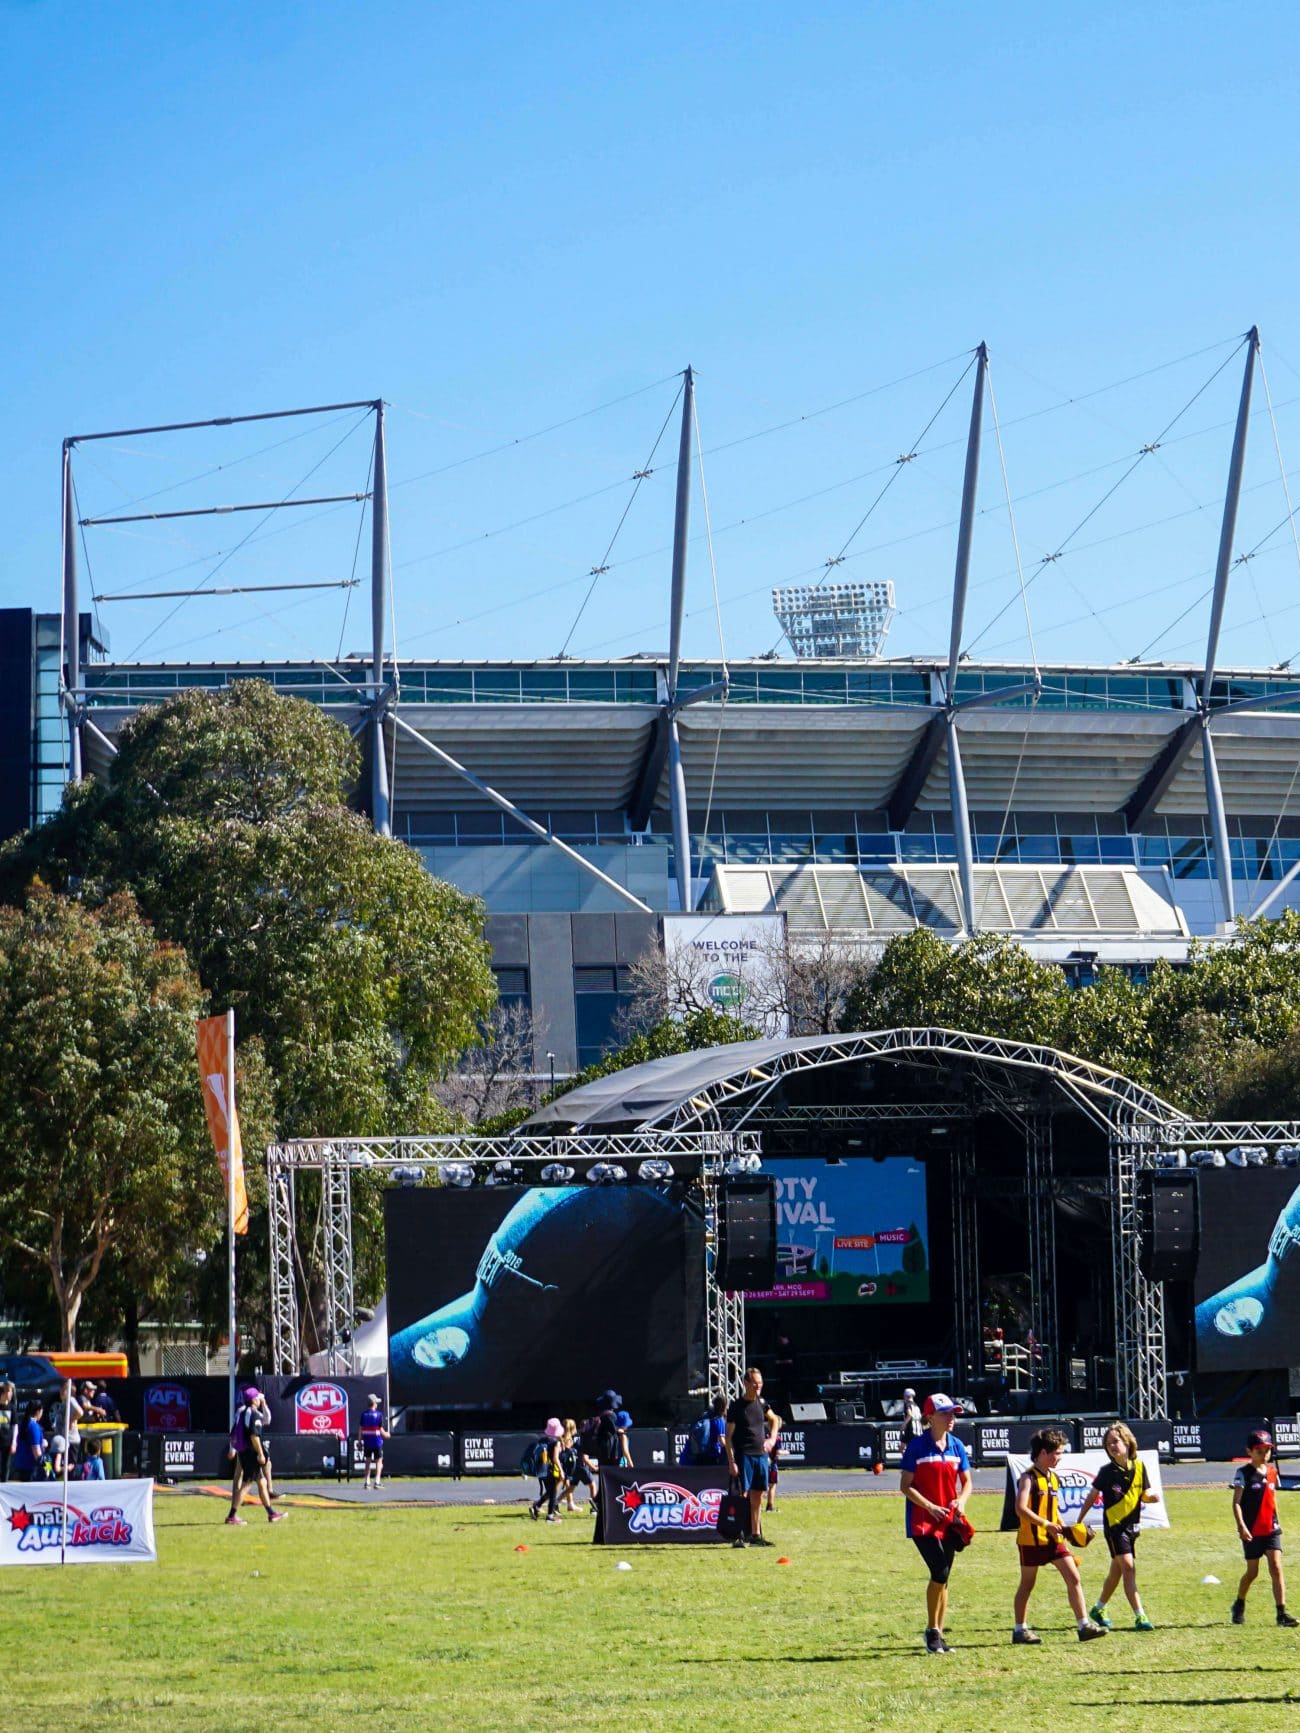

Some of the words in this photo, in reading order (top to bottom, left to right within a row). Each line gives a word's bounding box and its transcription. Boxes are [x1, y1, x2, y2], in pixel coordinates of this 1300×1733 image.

[692, 940, 758, 951] WELCOME
[703, 953, 720, 962] TO
[724, 952, 749, 962] THE
[879, 1234, 905, 1242] MUSIC
[837, 1241, 853, 1249] LIVE
[854, 1239, 869, 1248] SITE
[300, 1390, 344, 1407] AFL
[1083, 1427, 1099, 1437] CITY
[1173, 1425, 1190, 1435] CITY
[1191, 1425, 1201, 1435] OF
[1275, 1423, 1291, 1433] CITY
[675, 1434, 689, 1445] CIT
[794, 1432, 805, 1441] OF
[885, 1430, 901, 1441] CITY
[981, 1428, 998, 1440] CITY
[999, 1428, 1009, 1439] OF
[1173, 1434, 1201, 1445] EVENTS
[165, 1441, 183, 1451] CITY
[184, 1440, 195, 1450] OF
[464, 1438, 482, 1450] CITY
[483, 1438, 495, 1449] OF
[780, 1442, 805, 1451] VENTS
[981, 1438, 1010, 1449] EVENTS
[1083, 1437, 1104, 1447] EVEN
[164, 1451, 195, 1463] EVENTS
[464, 1448, 495, 1460] EVENTS
[644, 1489, 677, 1504] nab
[701, 1493, 722, 1503] AF
[93, 1510, 122, 1520] AFL
[633, 1503, 720, 1529] Auskic
